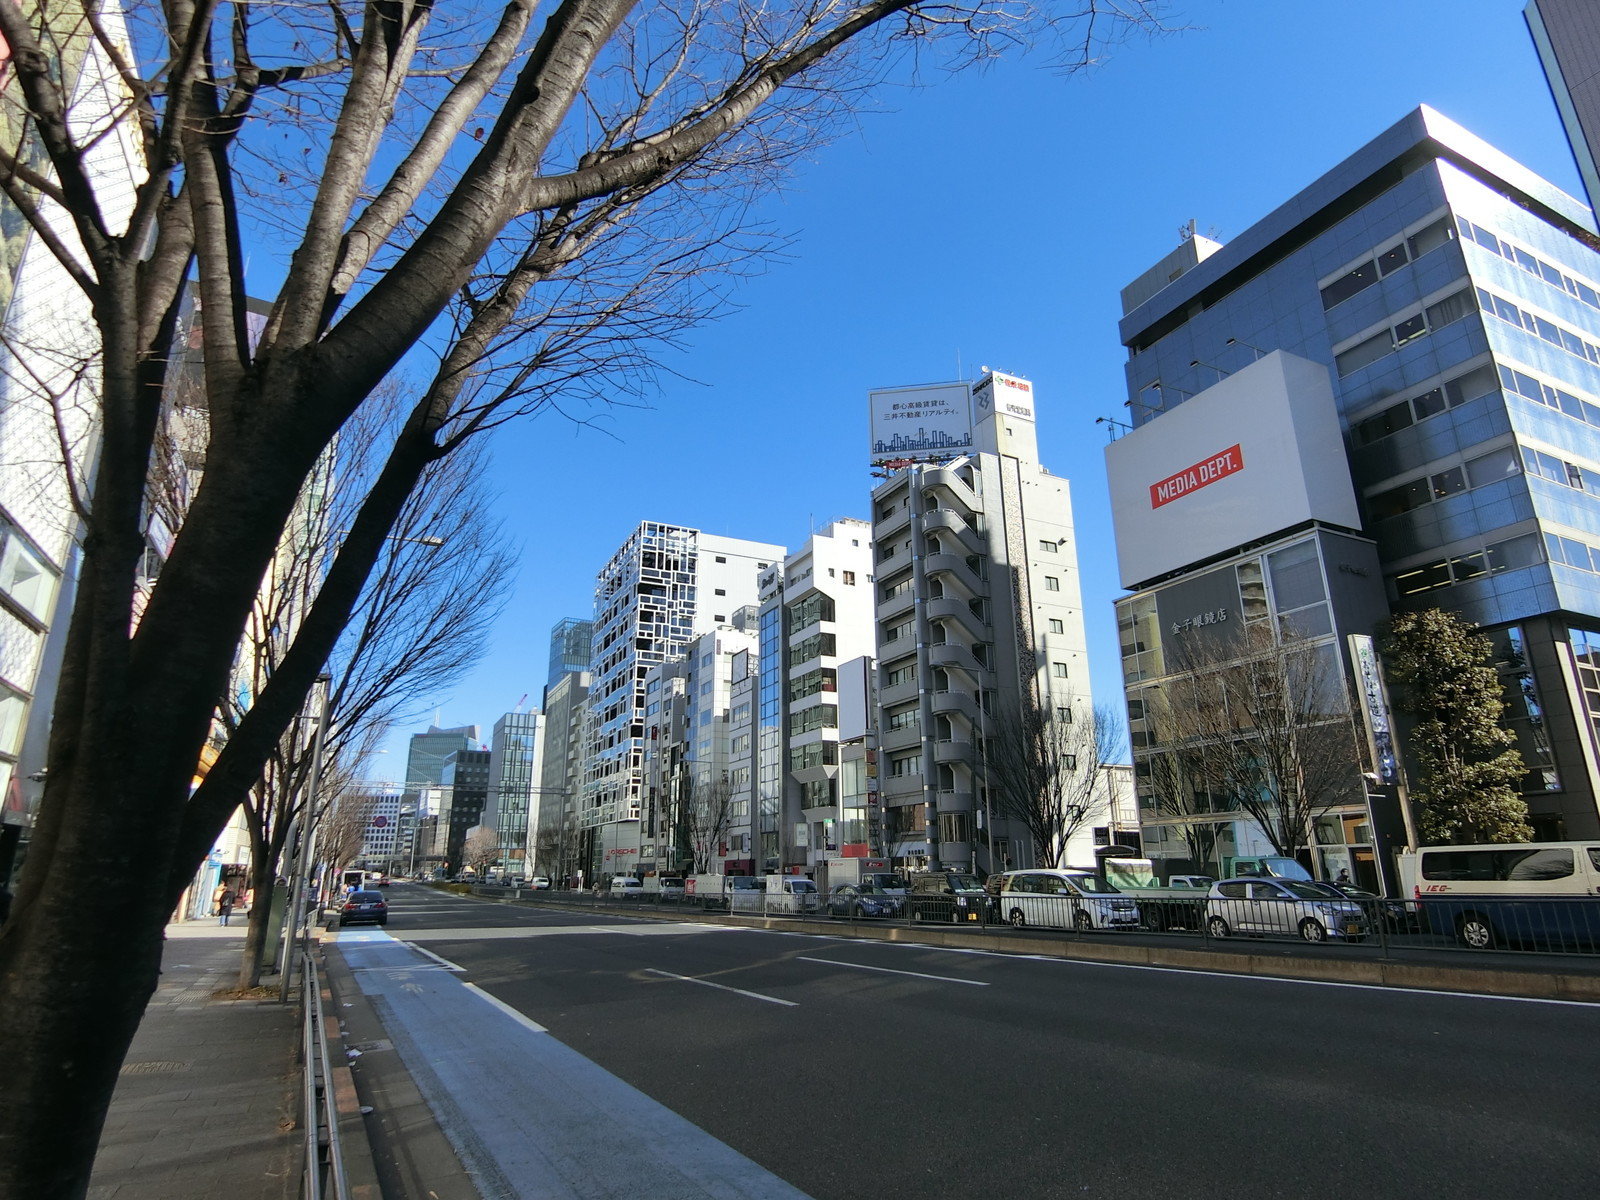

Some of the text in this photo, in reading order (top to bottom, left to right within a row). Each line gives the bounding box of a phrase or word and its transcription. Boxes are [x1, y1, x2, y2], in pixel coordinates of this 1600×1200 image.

[883, 408, 959, 421] 三井不動産リアルティ。
[892, 400, 949, 411] 都心高級賃貸は、
[1157, 452, 1237, 502] MEDIA DEPT.
[1171, 607, 1227, 635] 金子眼鏡店
